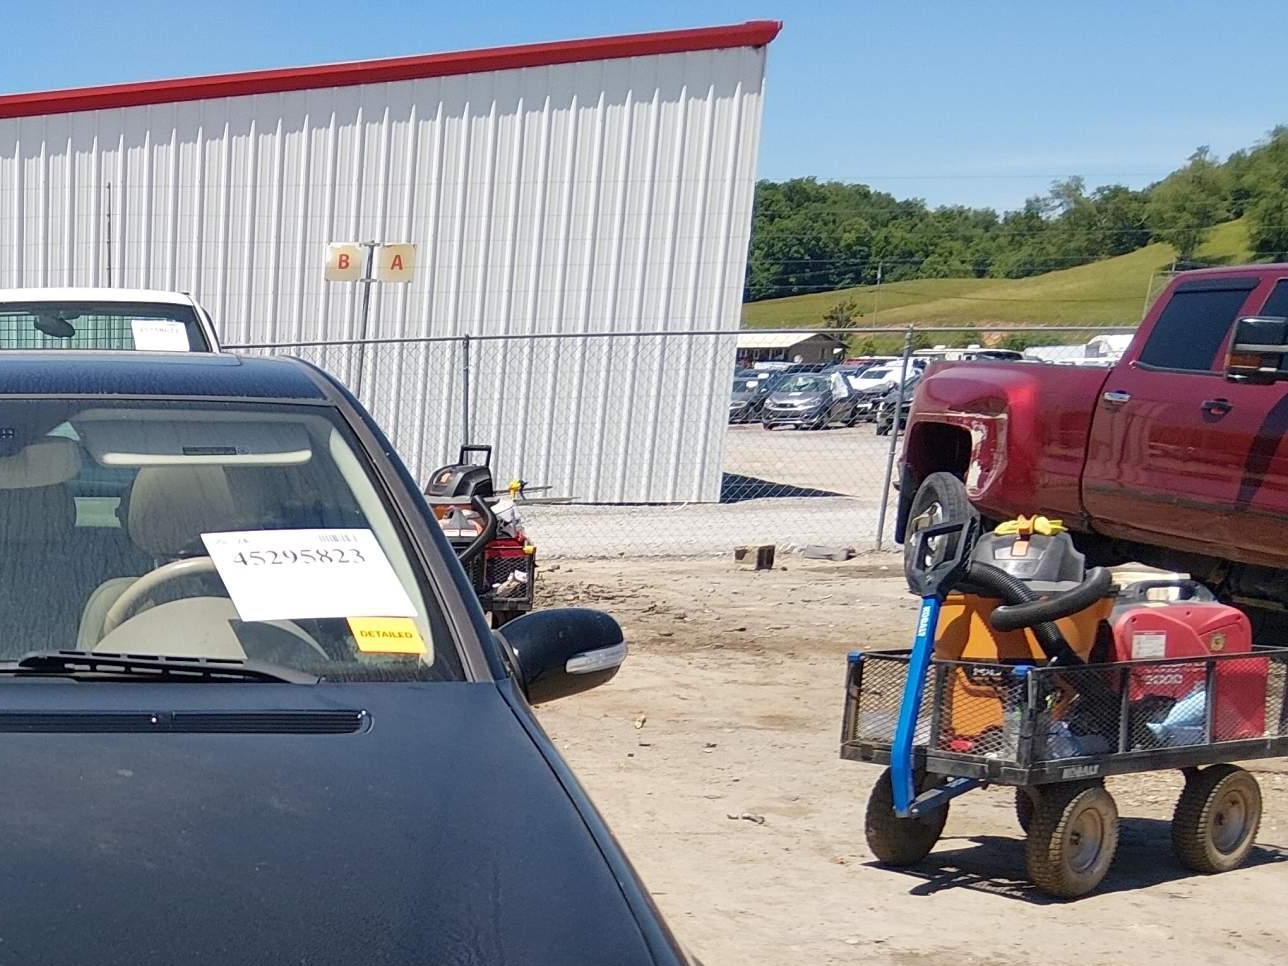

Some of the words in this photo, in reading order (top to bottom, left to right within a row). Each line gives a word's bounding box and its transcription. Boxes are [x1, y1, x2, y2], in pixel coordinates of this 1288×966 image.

[337, 253, 350, 270] B
[390, 254, 404, 271] A
[233, 548, 367, 567] 45295823
[359, 630, 413, 639] DETAILED
